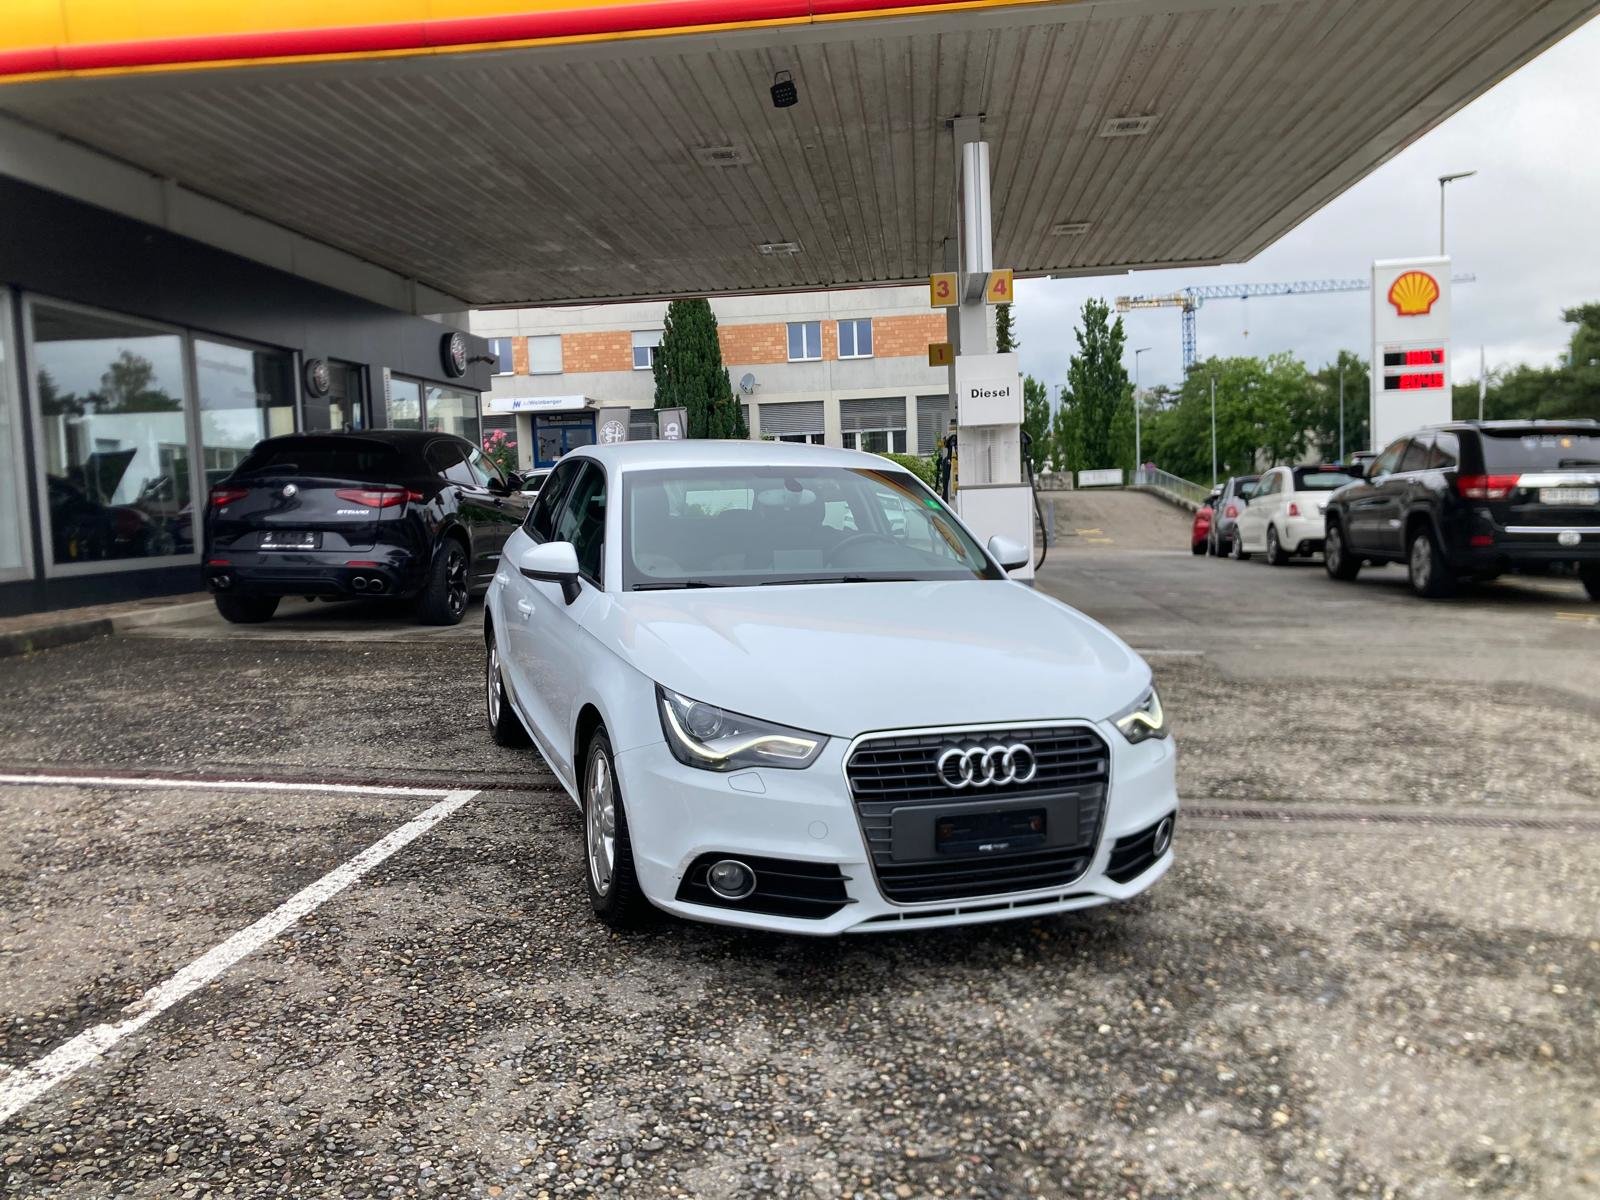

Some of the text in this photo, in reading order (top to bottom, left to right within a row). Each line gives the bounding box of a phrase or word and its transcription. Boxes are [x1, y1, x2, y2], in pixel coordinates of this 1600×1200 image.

[937, 280, 949, 298] 3
[993, 278, 1007, 296] 4
[937, 348, 944, 361] 1
[971, 387, 1010, 398] Diesel
